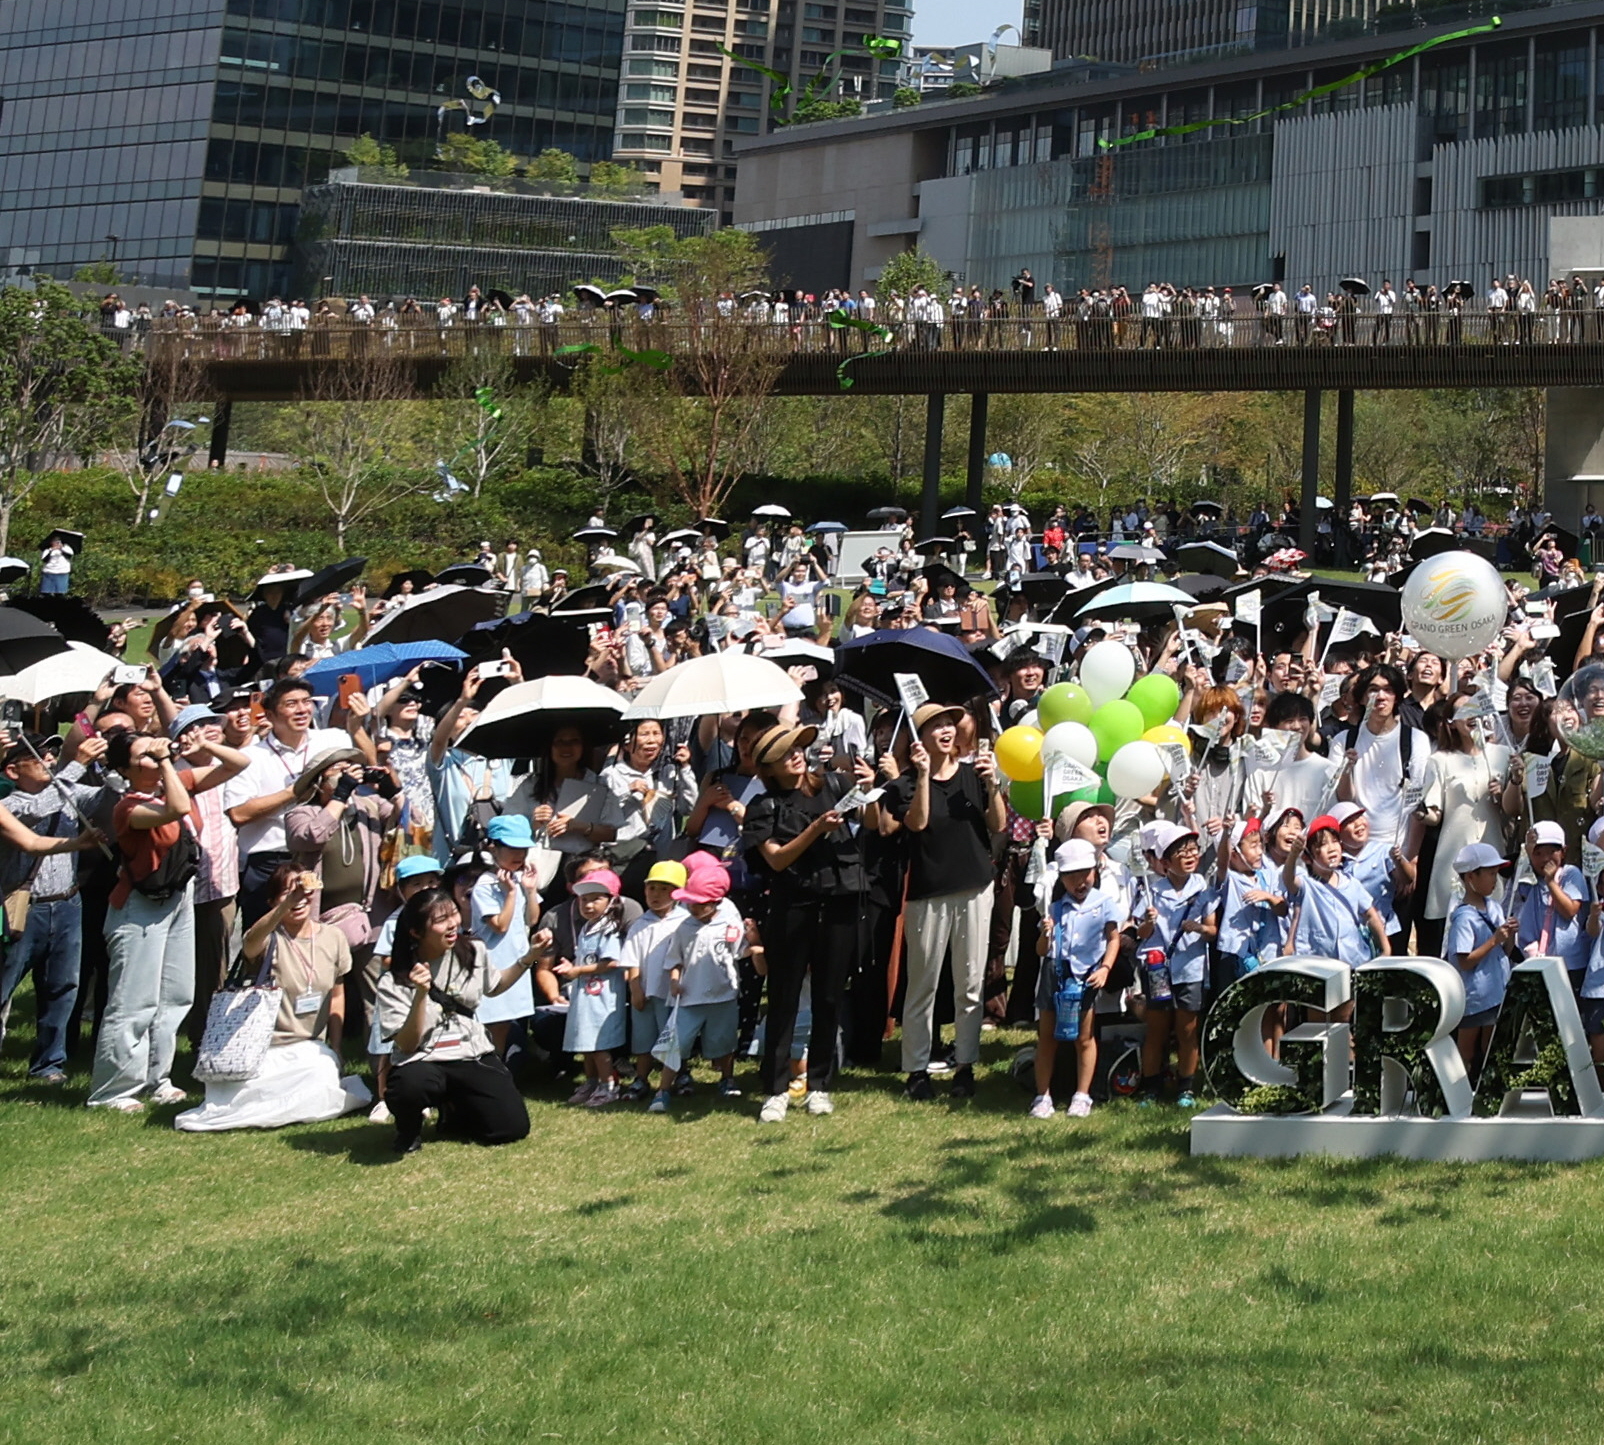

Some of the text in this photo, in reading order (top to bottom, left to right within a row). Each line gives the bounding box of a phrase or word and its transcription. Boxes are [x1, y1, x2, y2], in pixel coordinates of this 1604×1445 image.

[1411, 613, 1496, 634] GRAND GREEN OSAKA
